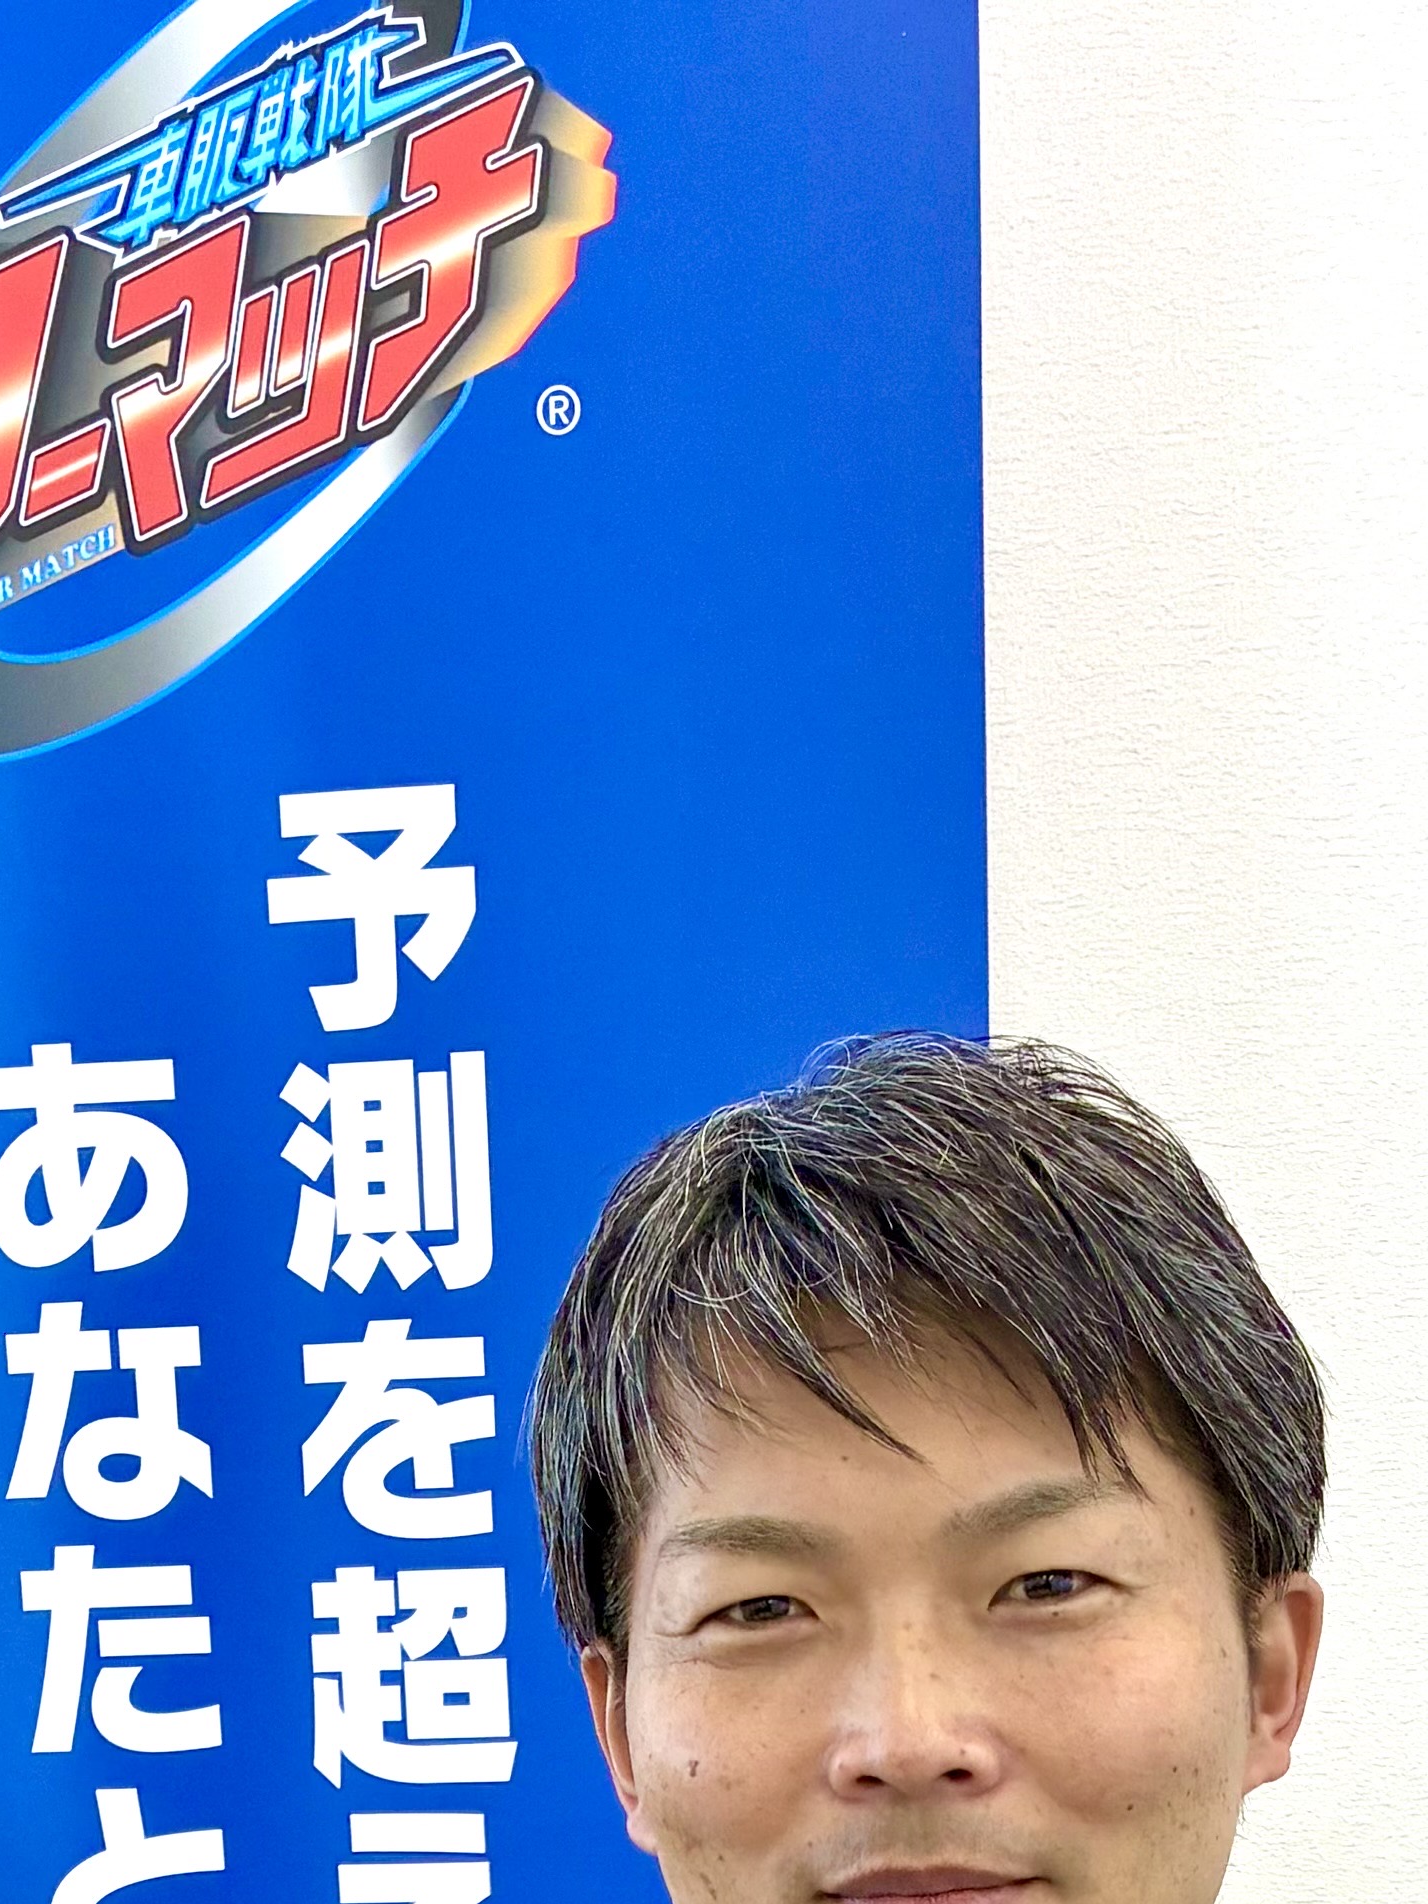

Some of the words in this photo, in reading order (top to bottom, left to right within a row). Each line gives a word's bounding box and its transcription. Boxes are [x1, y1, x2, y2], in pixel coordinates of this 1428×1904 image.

[107, 30, 387, 248] 車販戦隊
[20, 524, 118, 589] MATCH
